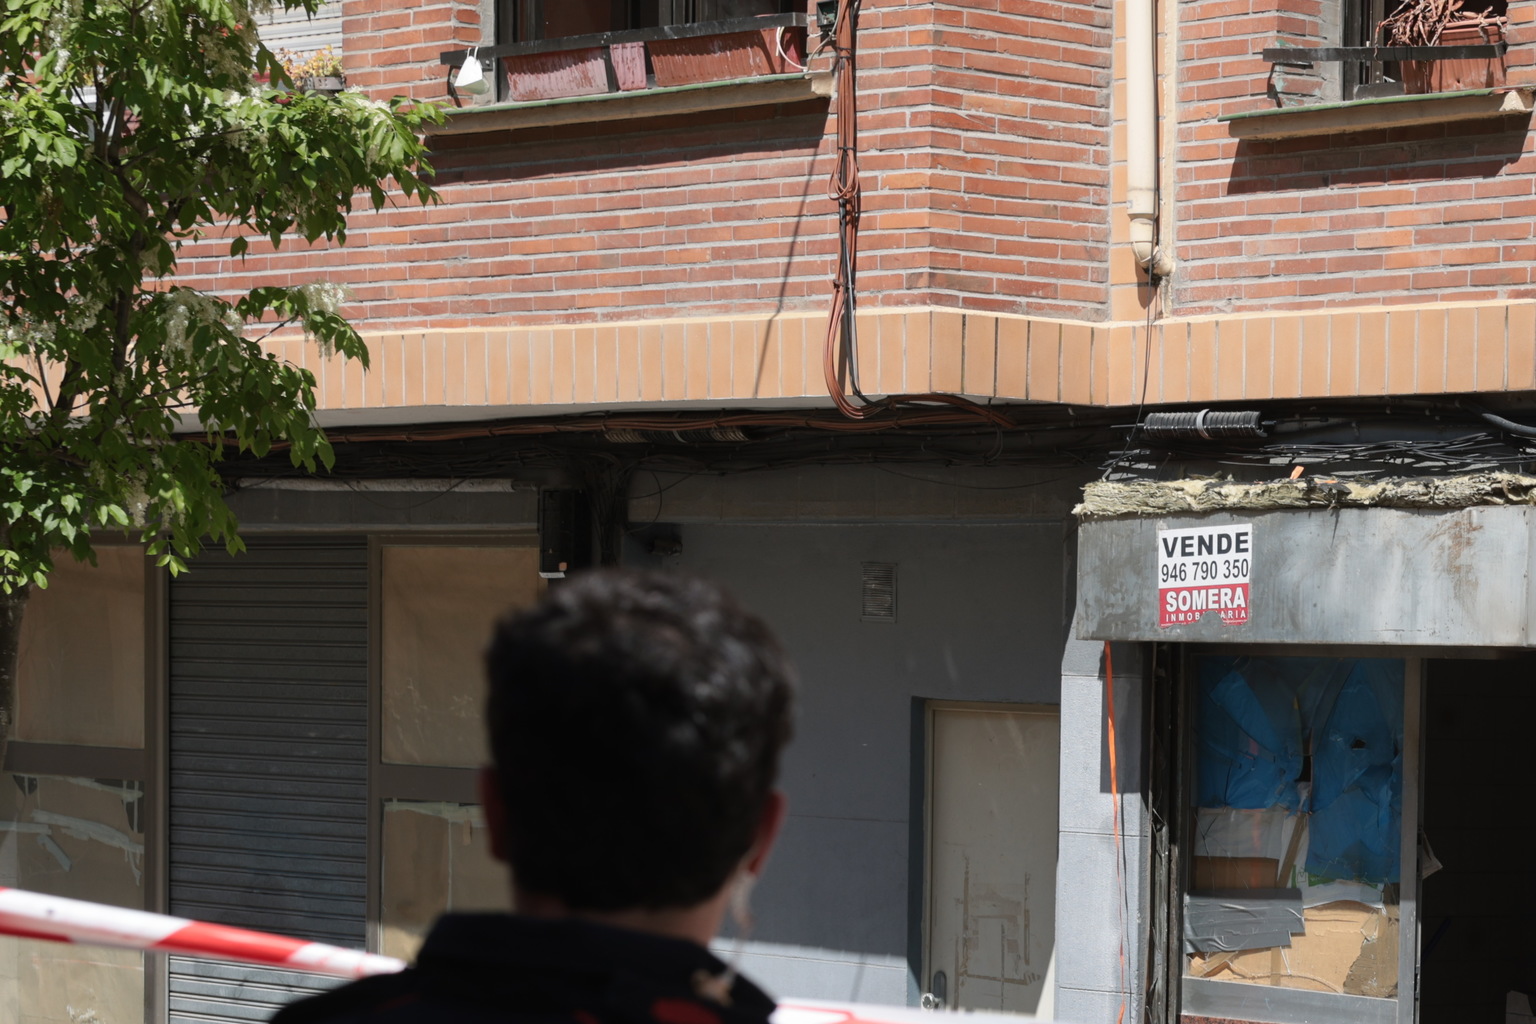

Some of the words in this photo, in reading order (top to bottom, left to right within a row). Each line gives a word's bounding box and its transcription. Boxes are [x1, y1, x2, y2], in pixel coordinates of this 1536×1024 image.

[1162, 531, 1249, 558] VENDE
[1161, 562, 1187, 583] 946
[1192, 560, 1218, 581] 790
[1223, 558, 1249, 579] 350
[1165, 587, 1246, 613] SOMERA
[1165, 609, 1247, 623] INMOBARIA
